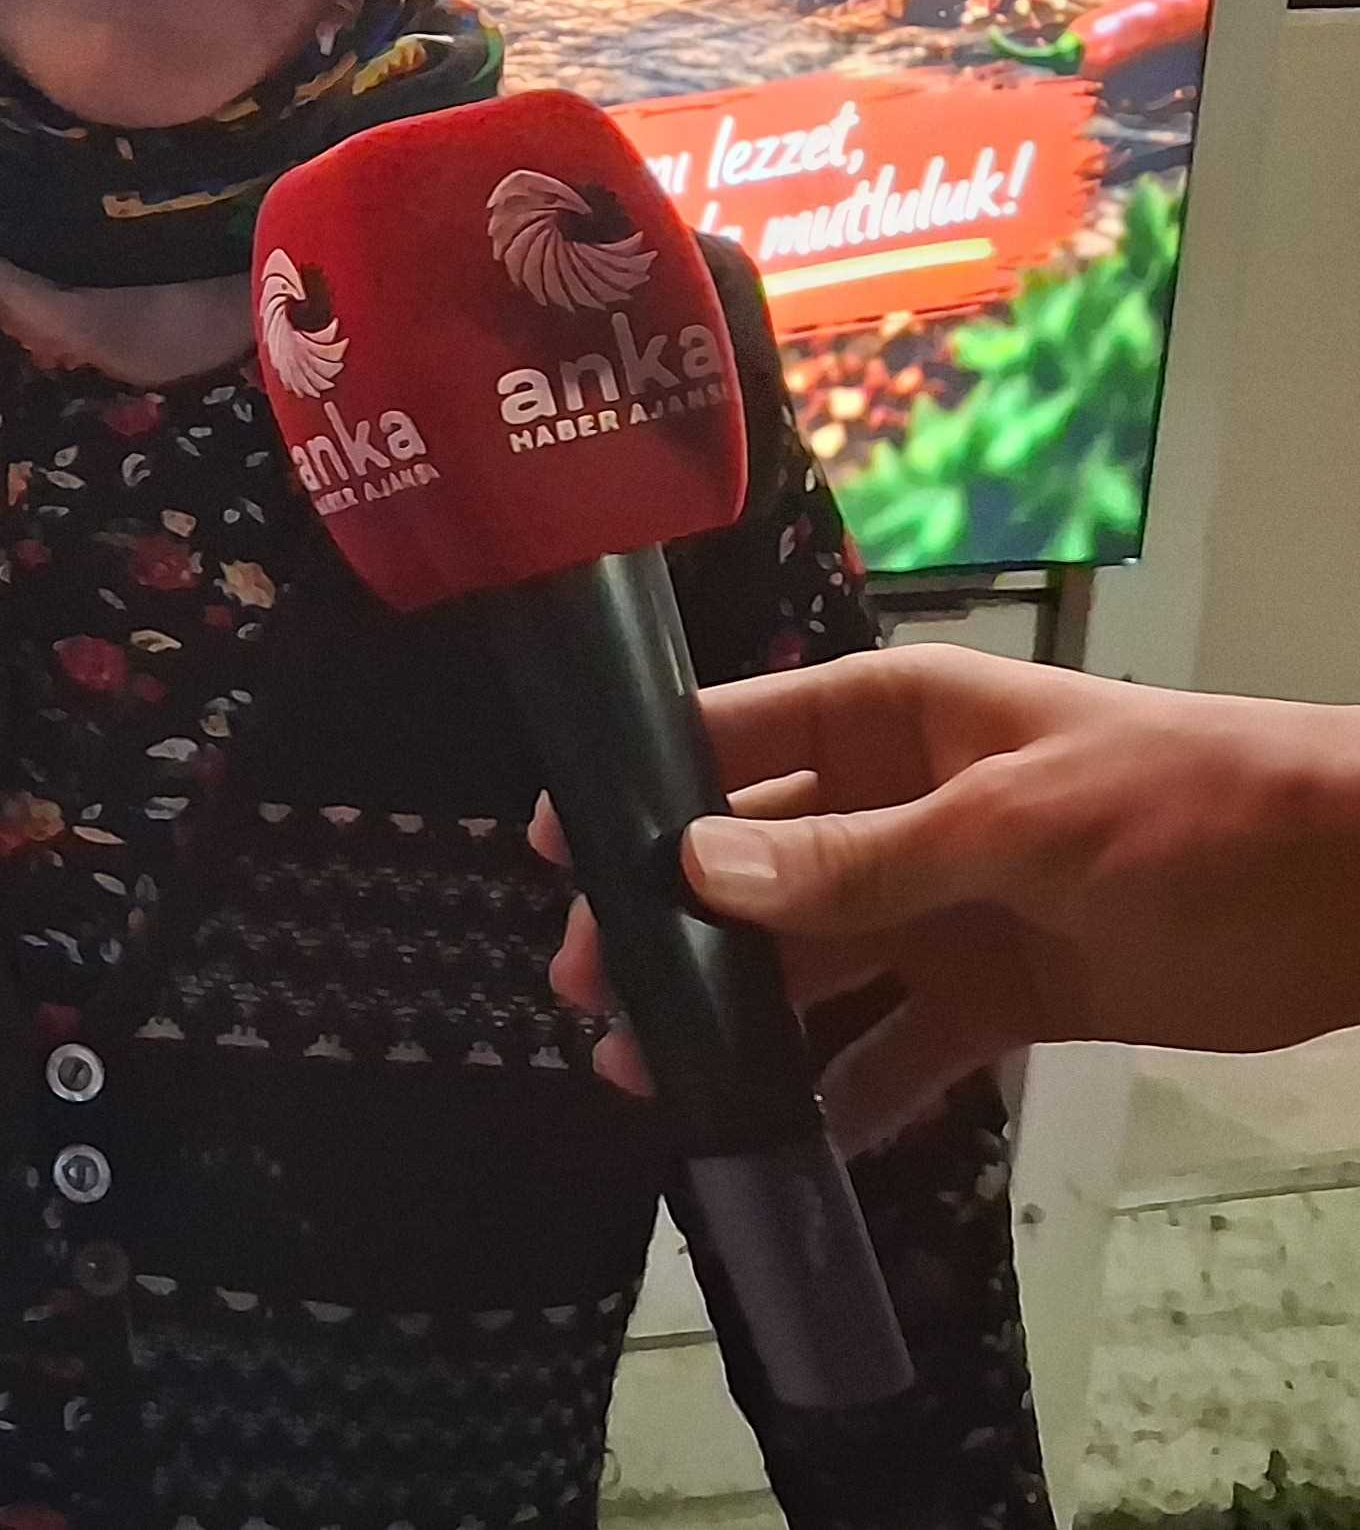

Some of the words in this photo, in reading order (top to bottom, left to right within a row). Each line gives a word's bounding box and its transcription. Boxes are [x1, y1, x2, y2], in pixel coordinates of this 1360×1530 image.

[708, 101, 864, 188] lezzet,
[758, 141, 1036, 261] mutluluk!
[497, 312, 723, 426] anka
[291, 401, 427, 492] anka
[509, 410, 620, 453] HABER
